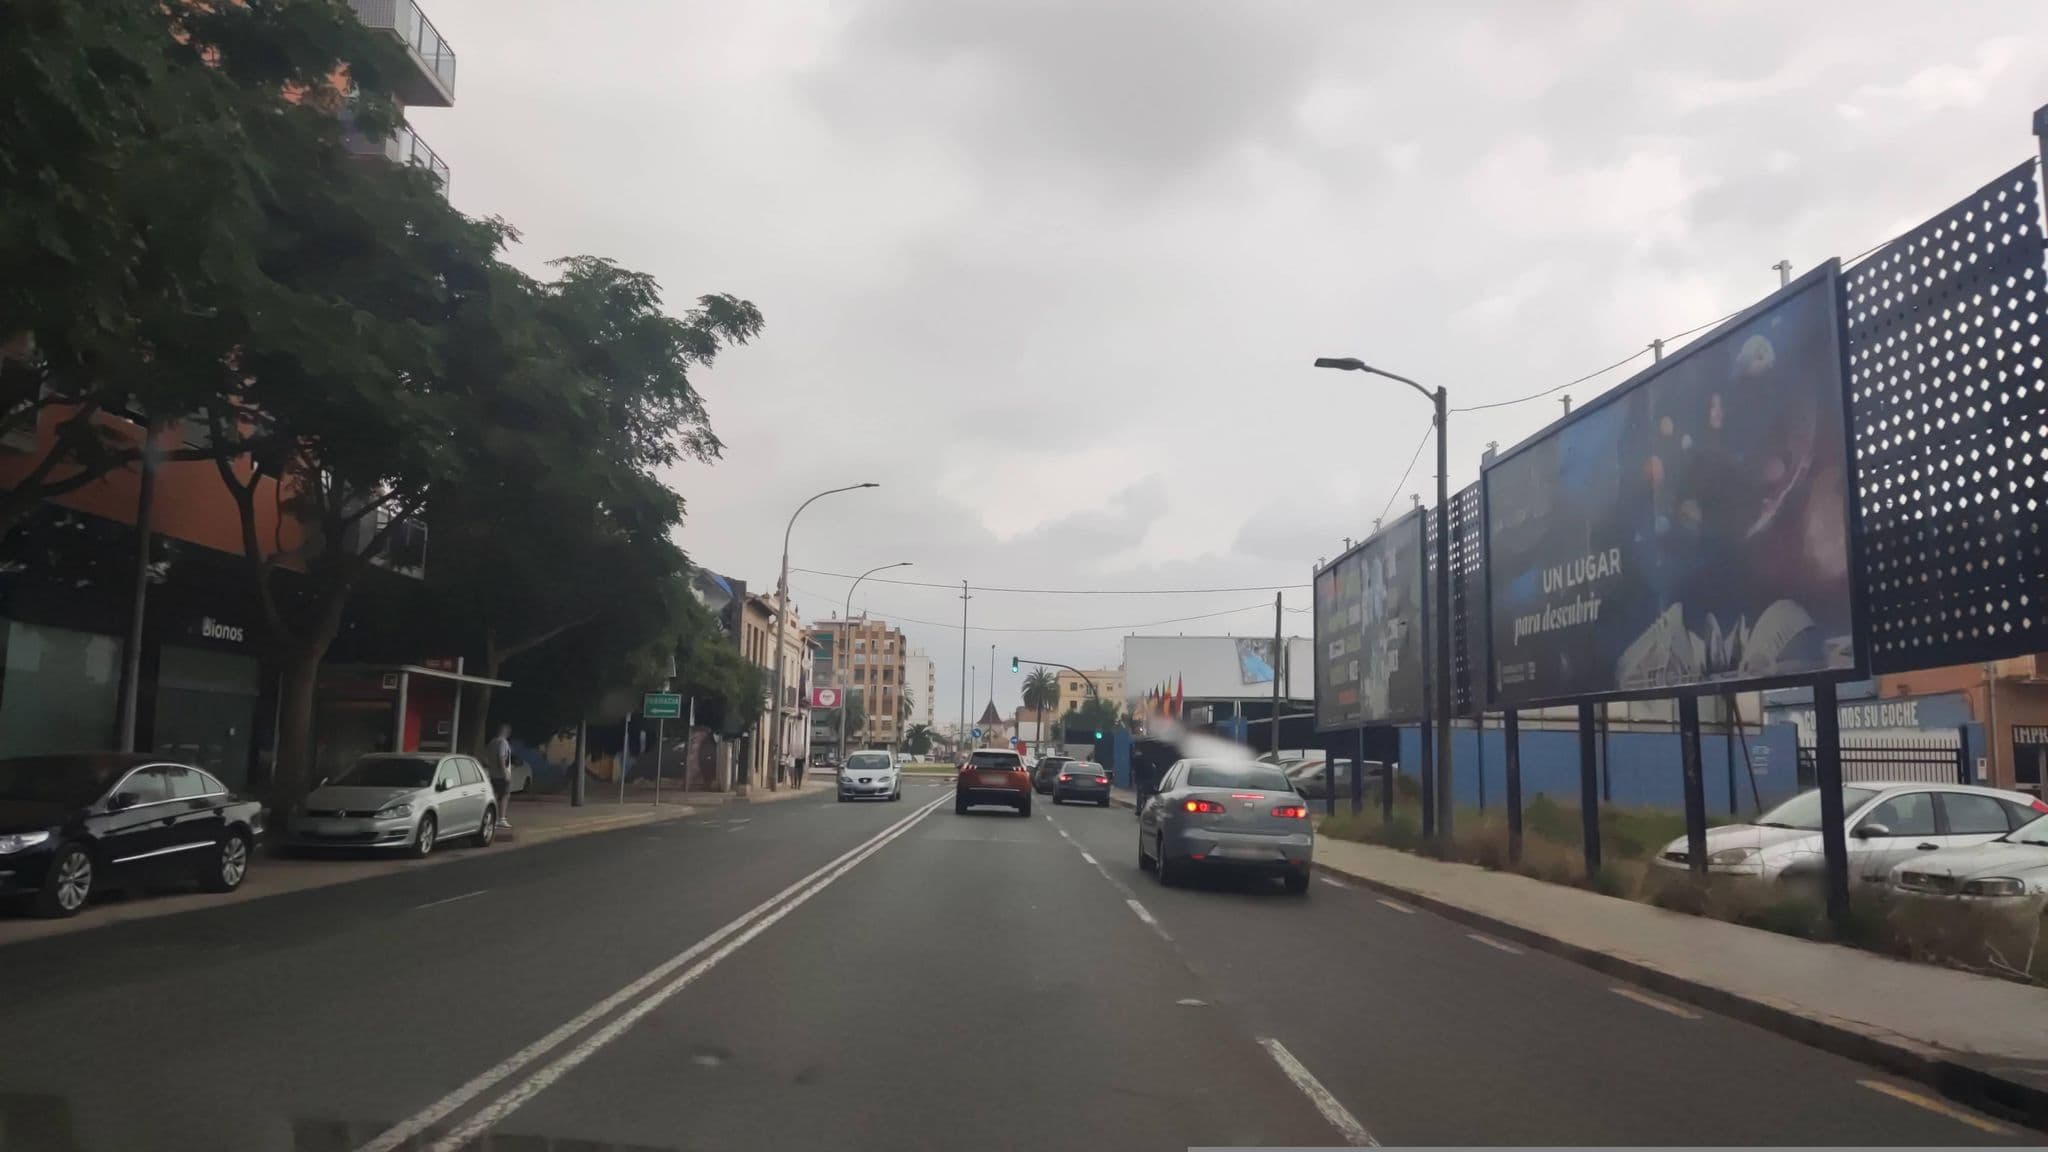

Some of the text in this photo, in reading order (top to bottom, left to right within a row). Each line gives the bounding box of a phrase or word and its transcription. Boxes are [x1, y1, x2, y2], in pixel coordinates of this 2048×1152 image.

[1543, 548, 1621, 593] UN LUGAR
[1514, 592, 1601, 646] para descubrir
[1864, 704, 1878, 728] SU
[1881, 701, 1919, 727] COCHE
